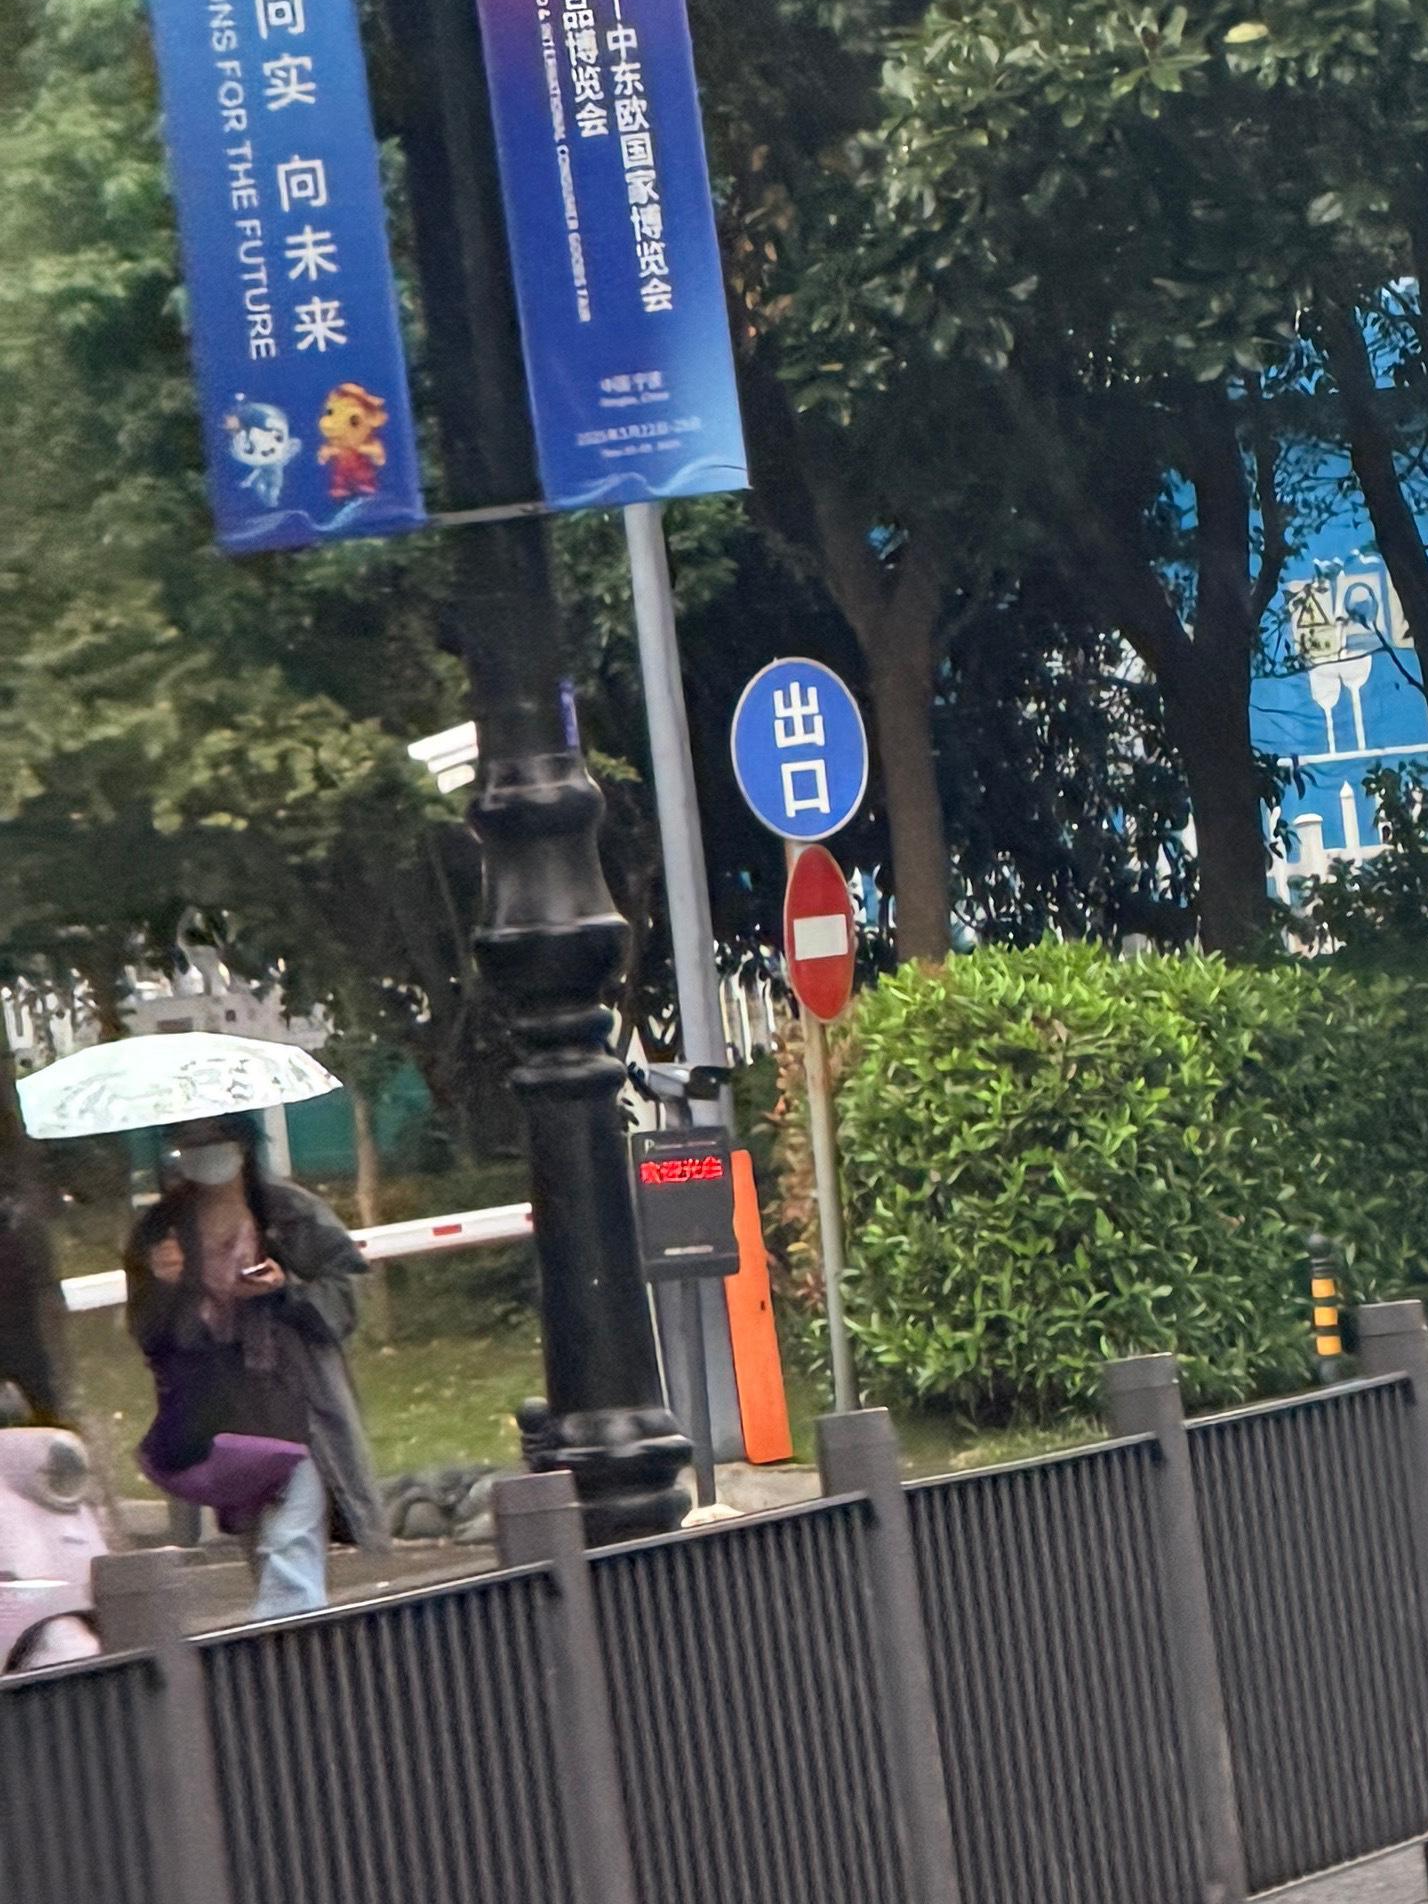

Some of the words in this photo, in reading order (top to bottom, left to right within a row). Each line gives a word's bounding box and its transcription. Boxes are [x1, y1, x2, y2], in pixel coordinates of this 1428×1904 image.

[216, 60, 248, 133] FOR
[226, 139, 259, 210] THE
[235, 218, 276, 361] FUTURE
[277, 154, 347, 352] 向未来
[773, 681, 831, 818] 出口
